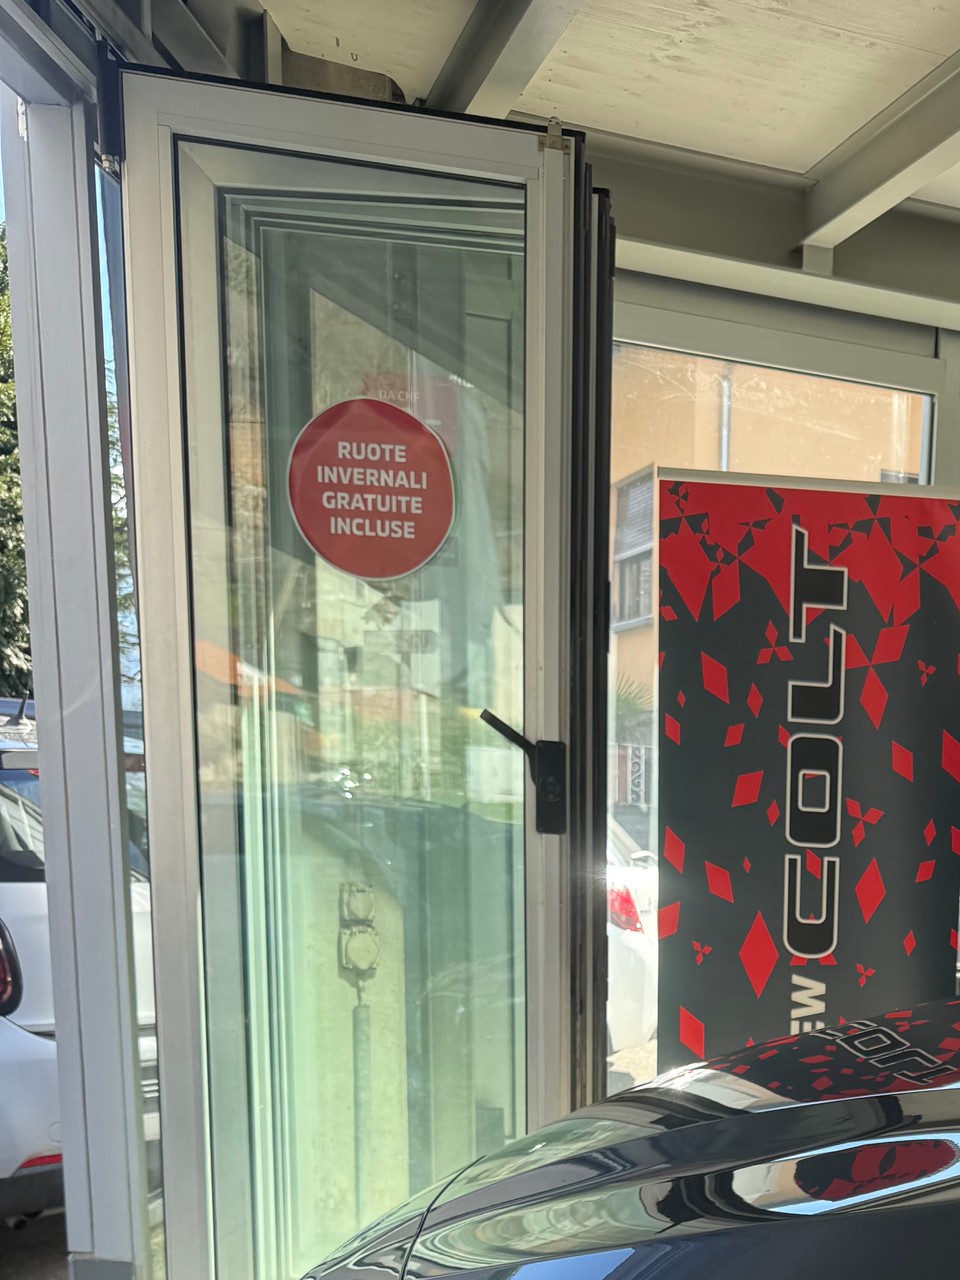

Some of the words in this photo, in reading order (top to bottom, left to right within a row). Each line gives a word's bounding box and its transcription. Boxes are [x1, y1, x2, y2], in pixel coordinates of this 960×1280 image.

[338, 441, 406, 463] RUOTE
[317, 465, 427, 490] INVERNALI
[322, 491, 423, 514] GRATUITE
[330, 516, 415, 539] INCLUSE
[783, 515, 850, 959] COLT
